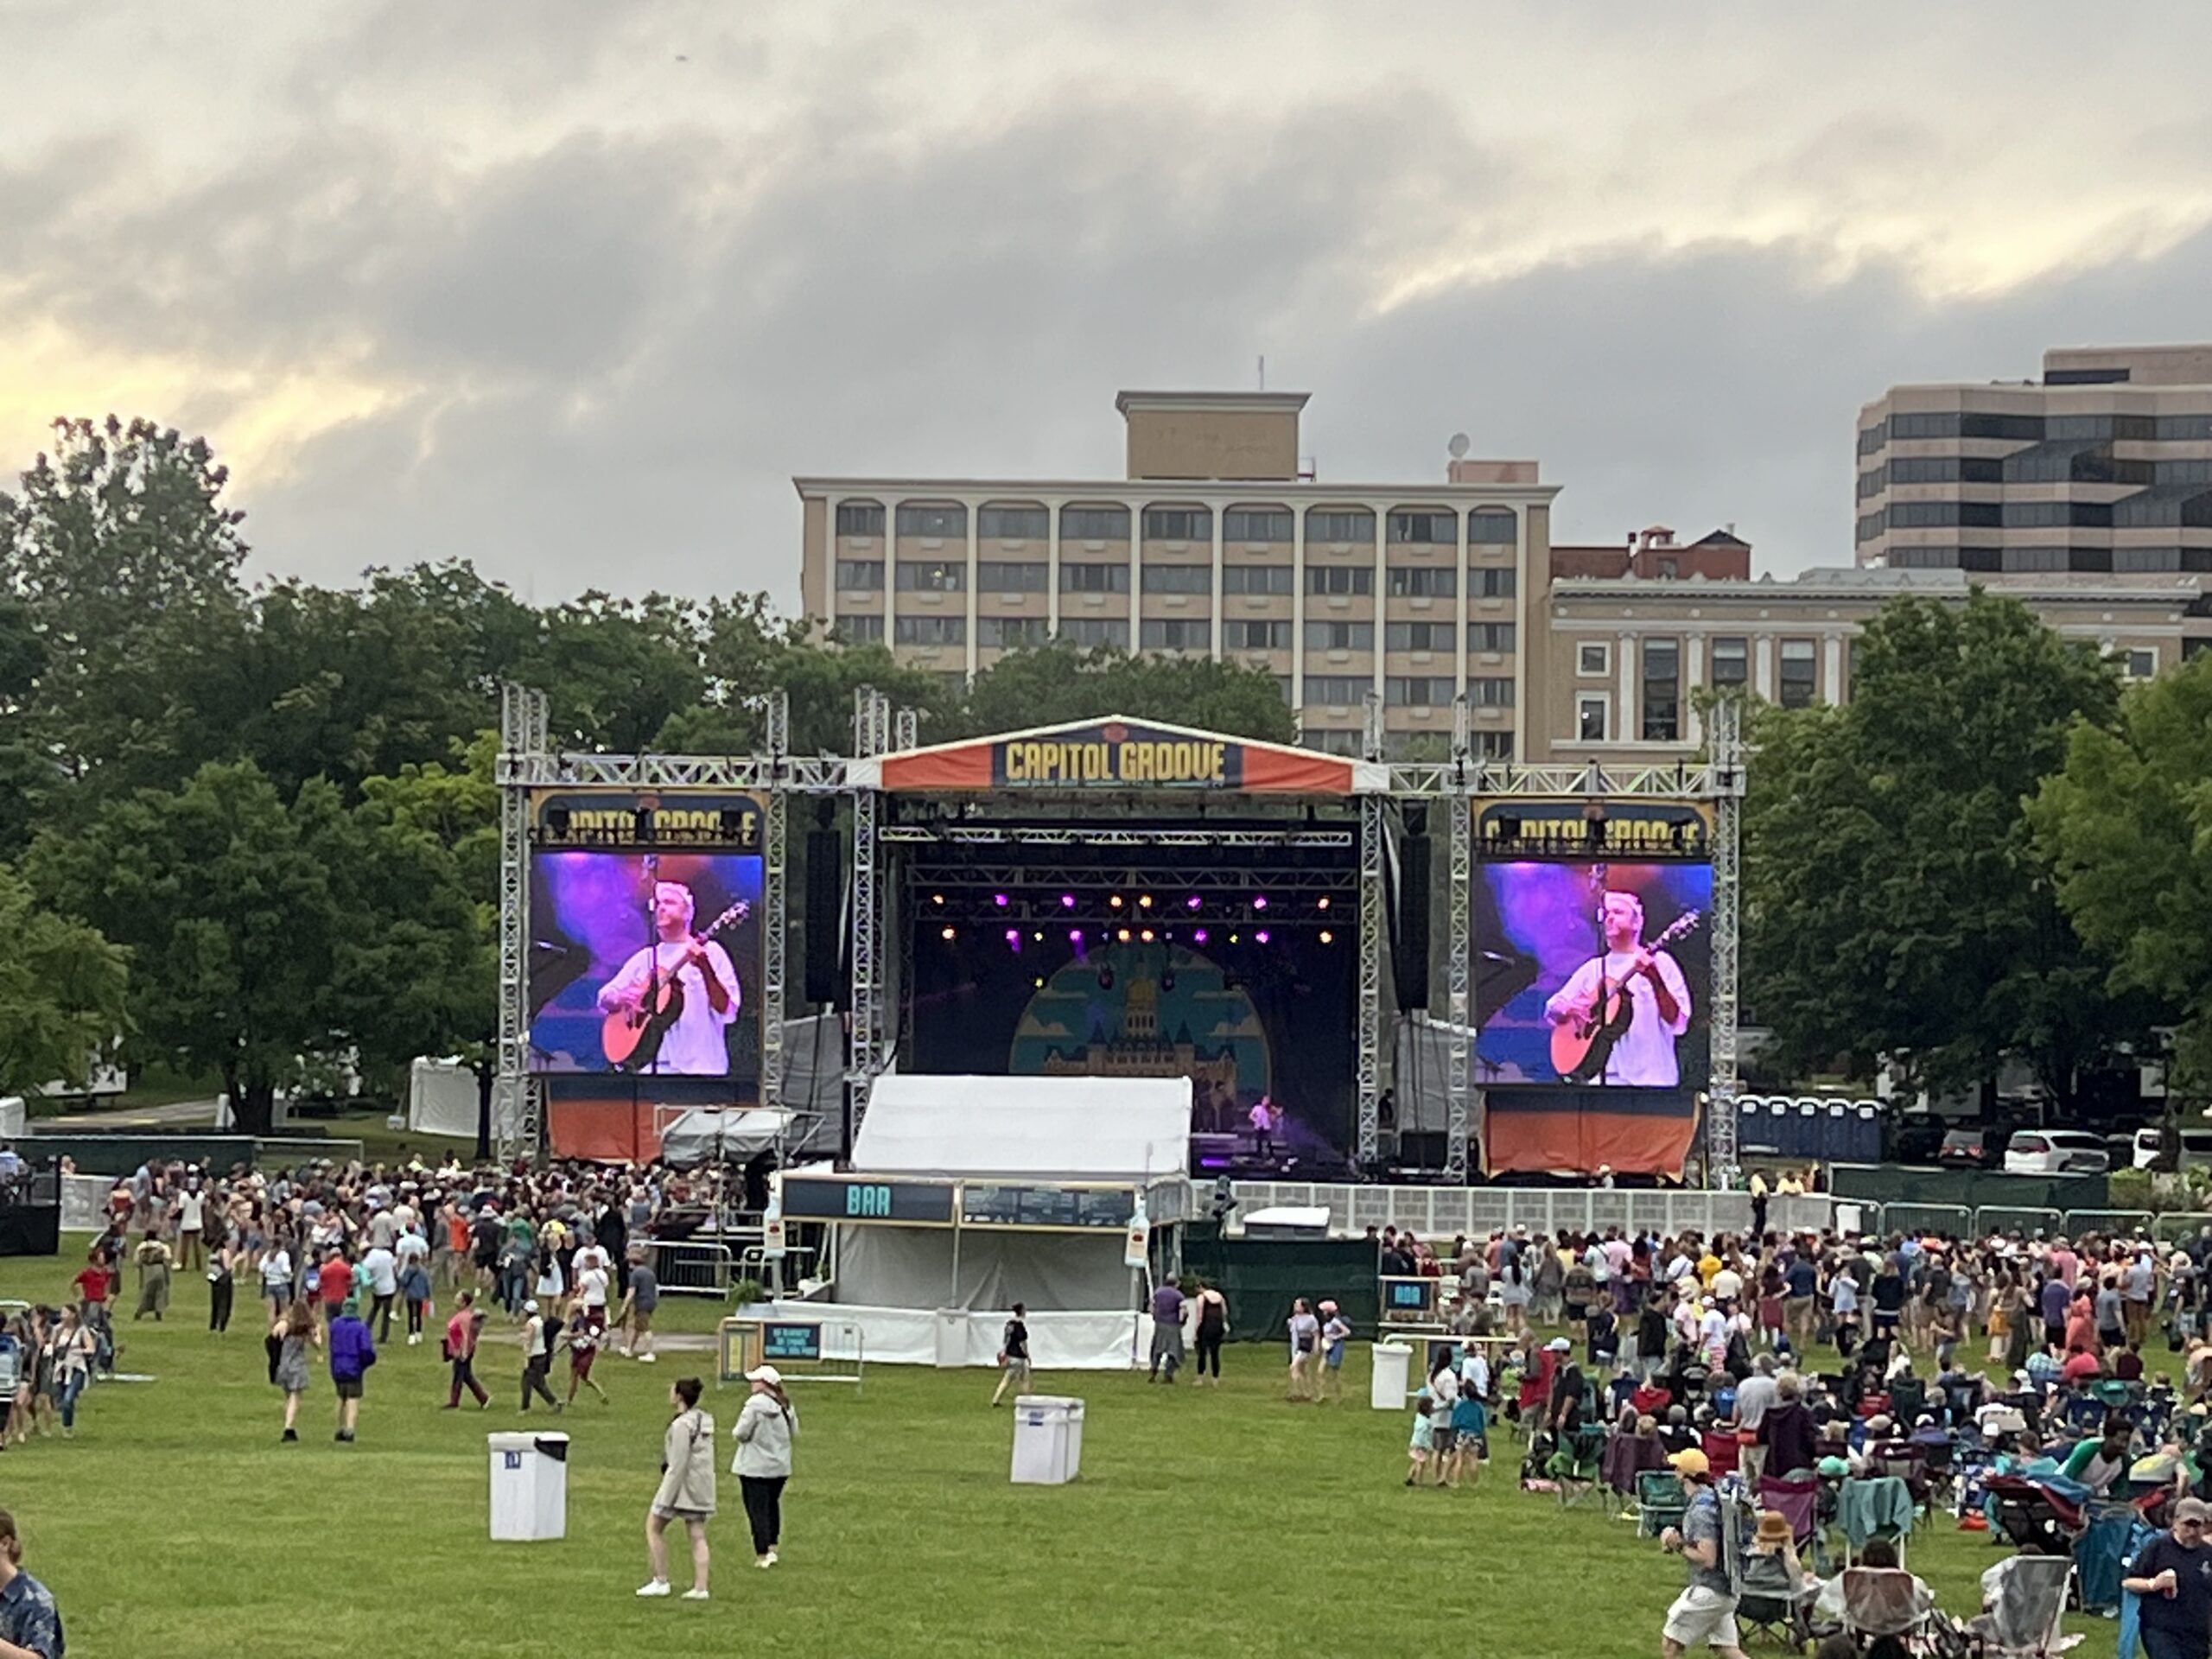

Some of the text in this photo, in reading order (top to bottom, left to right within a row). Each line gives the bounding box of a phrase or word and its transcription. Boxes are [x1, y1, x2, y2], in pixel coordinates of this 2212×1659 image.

[1006, 743, 1225, 780] CAPITOL GROOVE
[544, 810, 756, 845] PITO GROOE
[1596, 819, 1700, 855] ROOE
[847, 1185, 891, 1216] BAR
